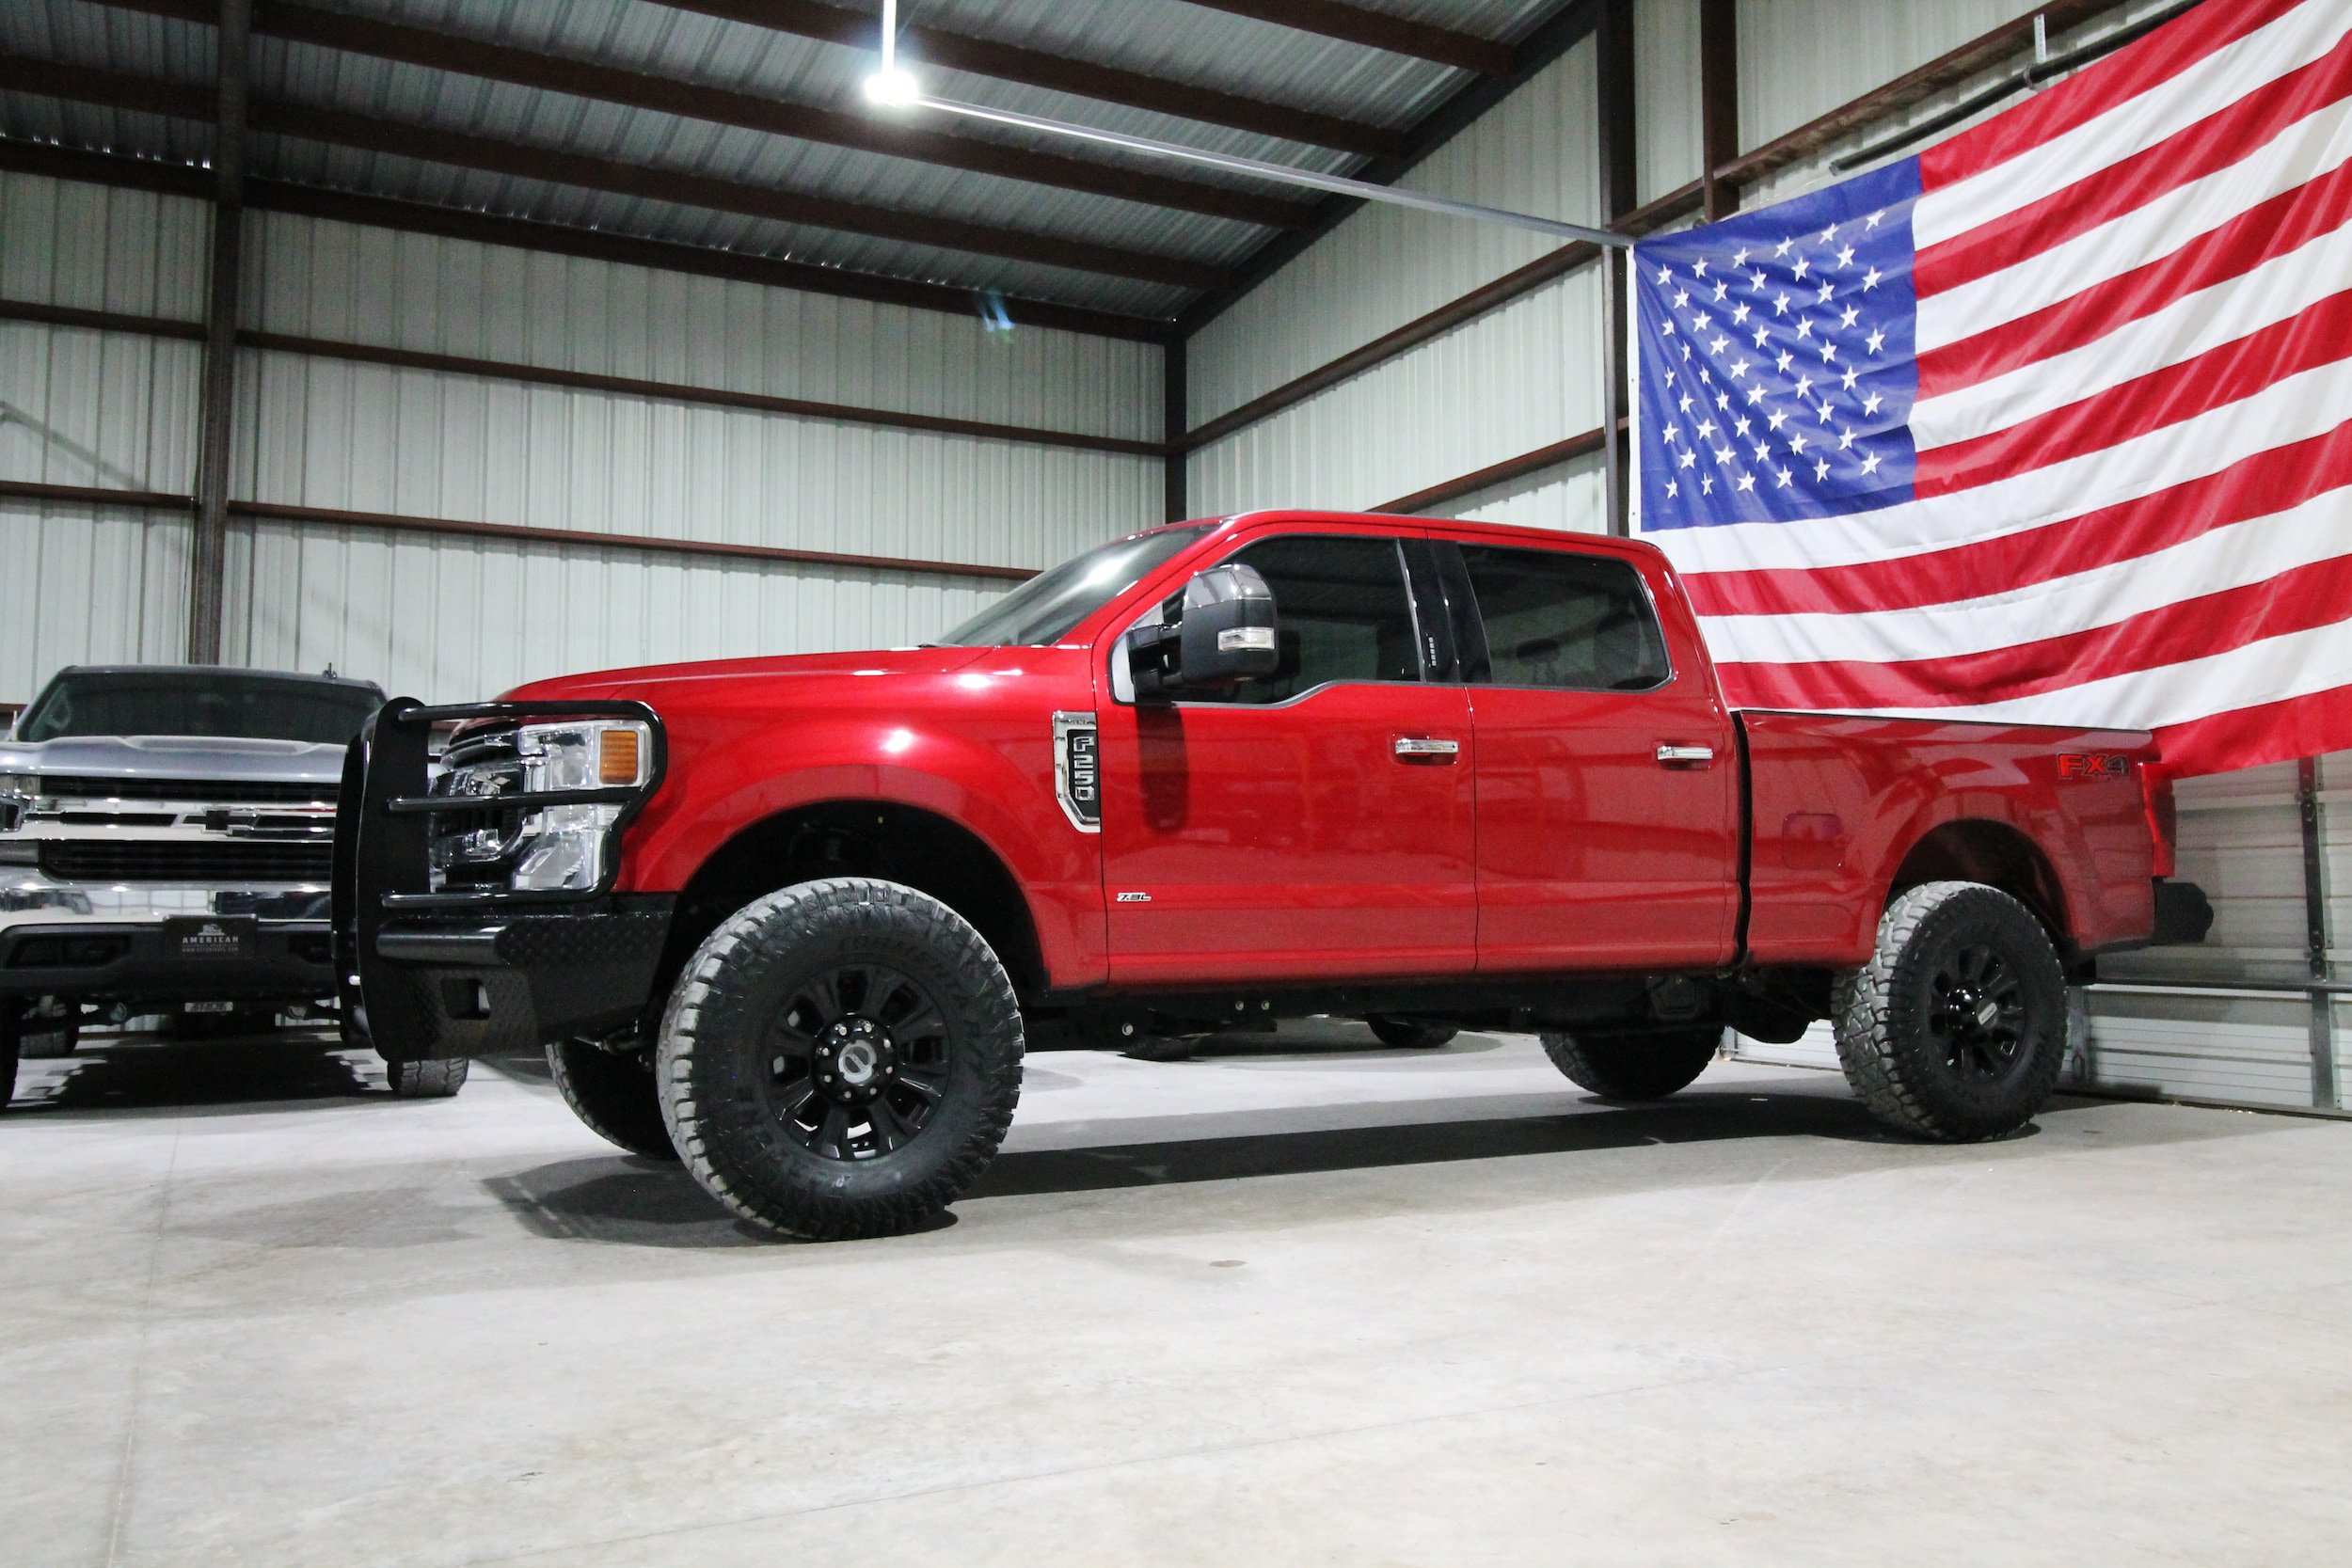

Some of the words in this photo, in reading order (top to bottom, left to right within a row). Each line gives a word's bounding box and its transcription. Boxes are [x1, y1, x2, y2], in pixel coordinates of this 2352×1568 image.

[1073, 736, 1094, 800] F250
[2058, 753, 2128, 779] FX4
[1117, 893, 1152, 902] 7.3L
[183, 936, 239, 944] AMERICAN
